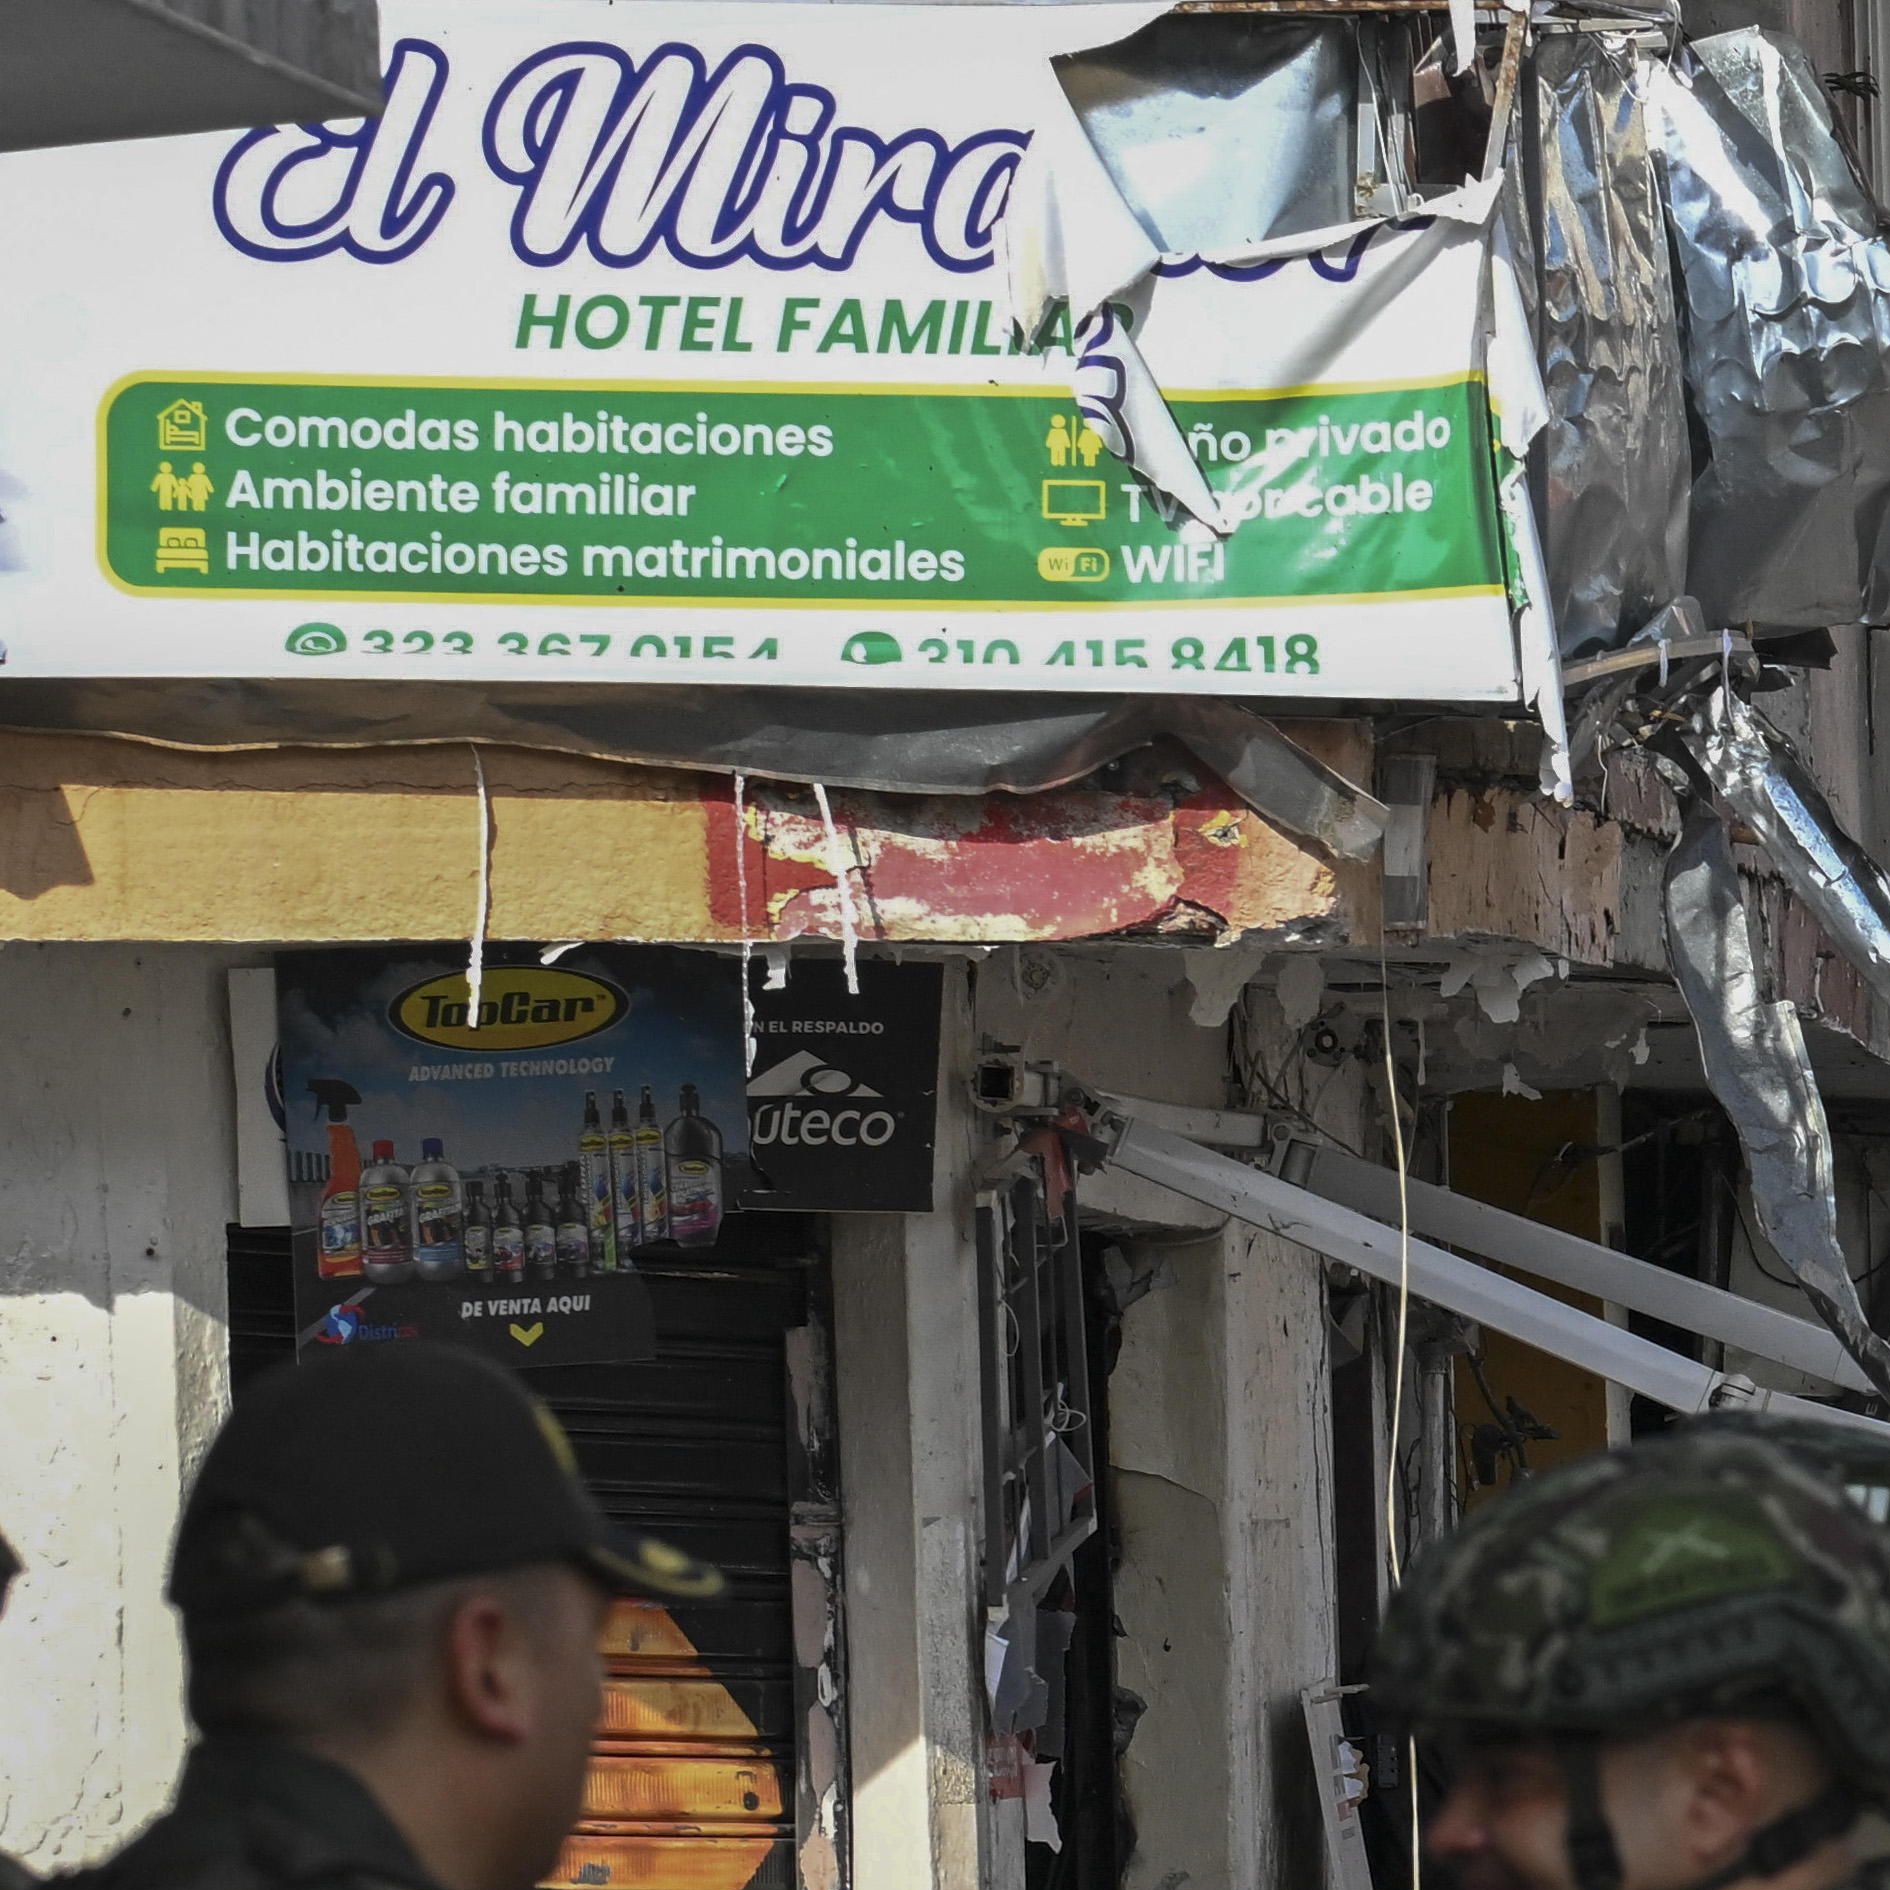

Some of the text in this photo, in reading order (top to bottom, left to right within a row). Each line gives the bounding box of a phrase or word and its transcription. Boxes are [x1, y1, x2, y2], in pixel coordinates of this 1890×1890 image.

[213, 38, 456, 266] El
[515, 293, 753, 353] HOTEL
[225, 407, 834, 458] Comodas habitaciones
[1265, 410, 1452, 463] privado
[226, 467, 697, 520] Ambiente familiar
[1300, 472, 1434, 518] cable
[226, 531, 966, 583] Habitaciones matrimoniales
[1121, 544, 1225, 584] WIFI
[362, 629, 474, 655] 323
[497, 631, 611, 656] 367
[917, 637, 1021, 665] 310
[1171, 632, 1320, 675] 8418
[421, 988, 598, 1030] TopCar
[768, 1020, 788, 1034] EL
[791, 1020, 885, 1035] RESPALDO
[408, 1056, 616, 1083] ADVANCED TECHNOLOGY
[752, 1101, 896, 1147] uteco
[461, 1294, 591, 1319] DE VENTA AQUI
